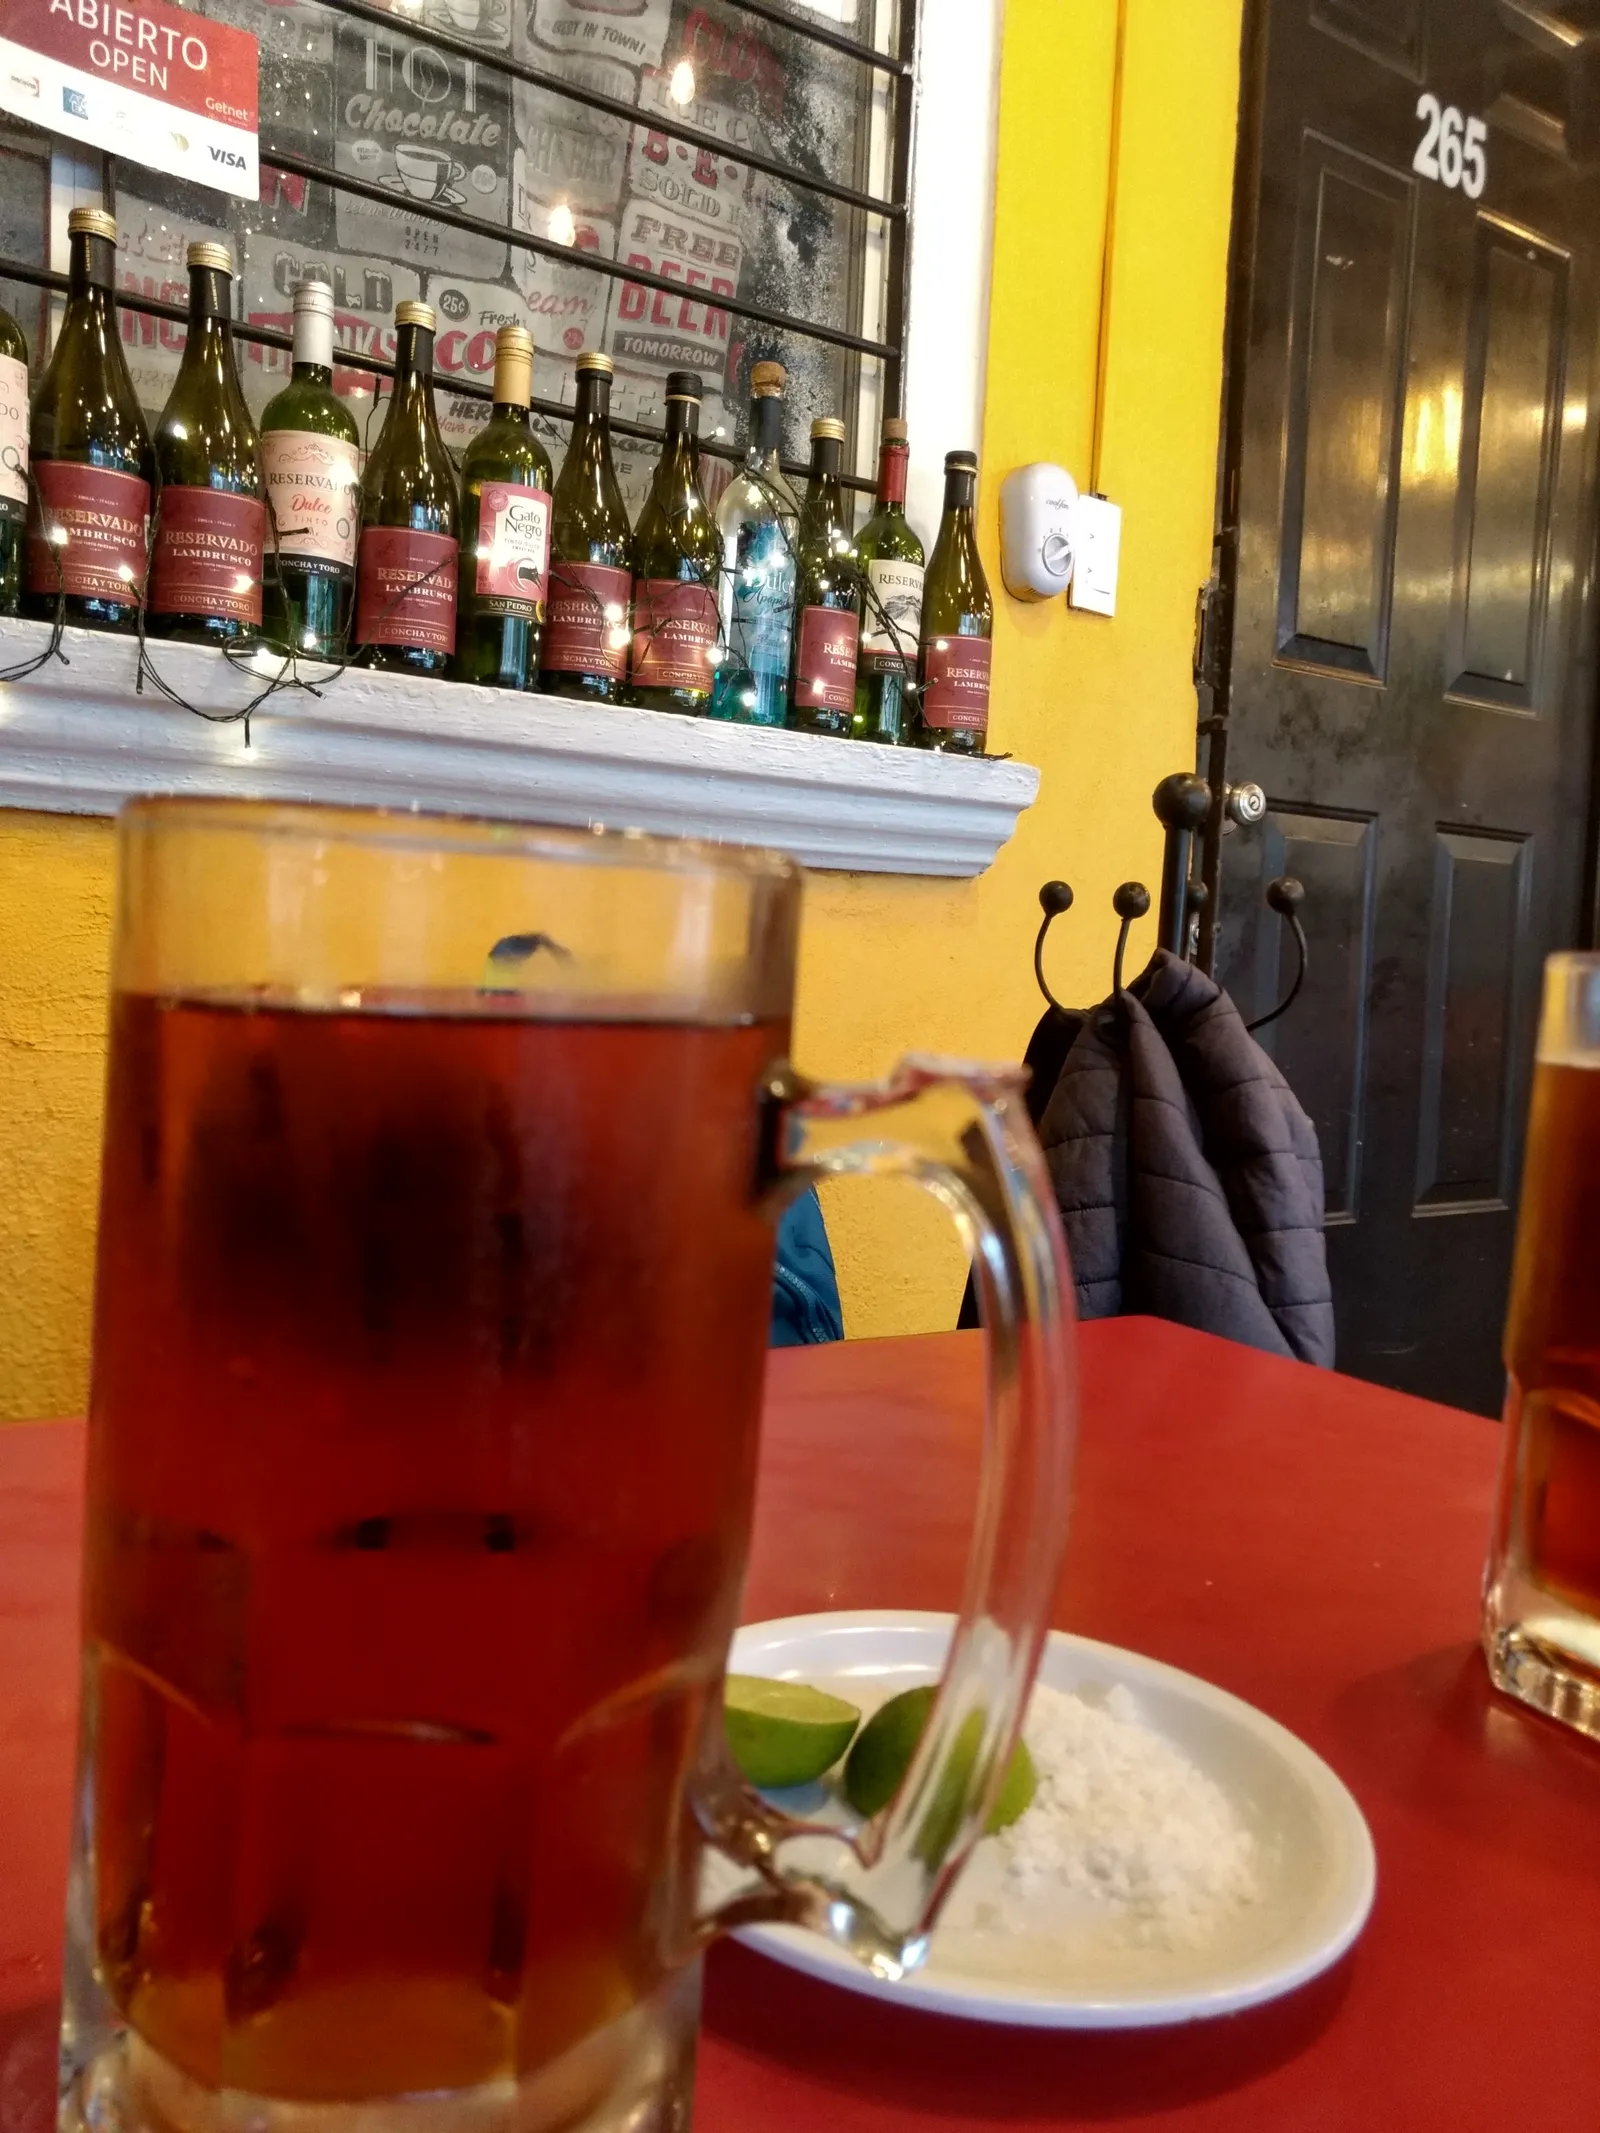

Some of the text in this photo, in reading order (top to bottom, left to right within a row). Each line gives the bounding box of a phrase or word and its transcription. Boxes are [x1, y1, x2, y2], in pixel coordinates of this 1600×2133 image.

[50, 0, 208, 71] ABIERTO
[582, 22, 598, 39] IN
[90, 40, 169, 92] OPEN
[364, 37, 480, 114] HOT
[205, 96, 249, 121] Getnet
[344, 93, 501, 148] Chocolate
[1412, 93, 1487, 199] 265
[208, 145, 247, 171] VISA
[639, 167, 721, 218] SOLD
[630, 213, 741, 270] FREE
[617, 253, 735, 340] BEER
[478, 310, 521, 327] Fresh
[623, 336, 719, 368] TOMORROW
[448, 400, 493, 422] HER
[291, 493, 333, 515] Dulce
[509, 504, 541, 525] Gato
[294, 515, 329, 527] TINTO
[504, 517, 542, 540] Negro
[62, 527, 137, 549] MBRUSCO
[164, 530, 258, 557] RESERVADO
[172, 548, 252, 567] LAMBRUSCO
[319, 563, 340, 574] TORO
[377, 567, 455, 590] RESERVAD
[173, 594, 218, 605] CONCHA
[225, 600, 250, 612] TORO
[489, 599, 533, 612] SAN PEDRO
[384, 627, 425, 638] CONCHA
[432, 632, 448, 643] TOR
